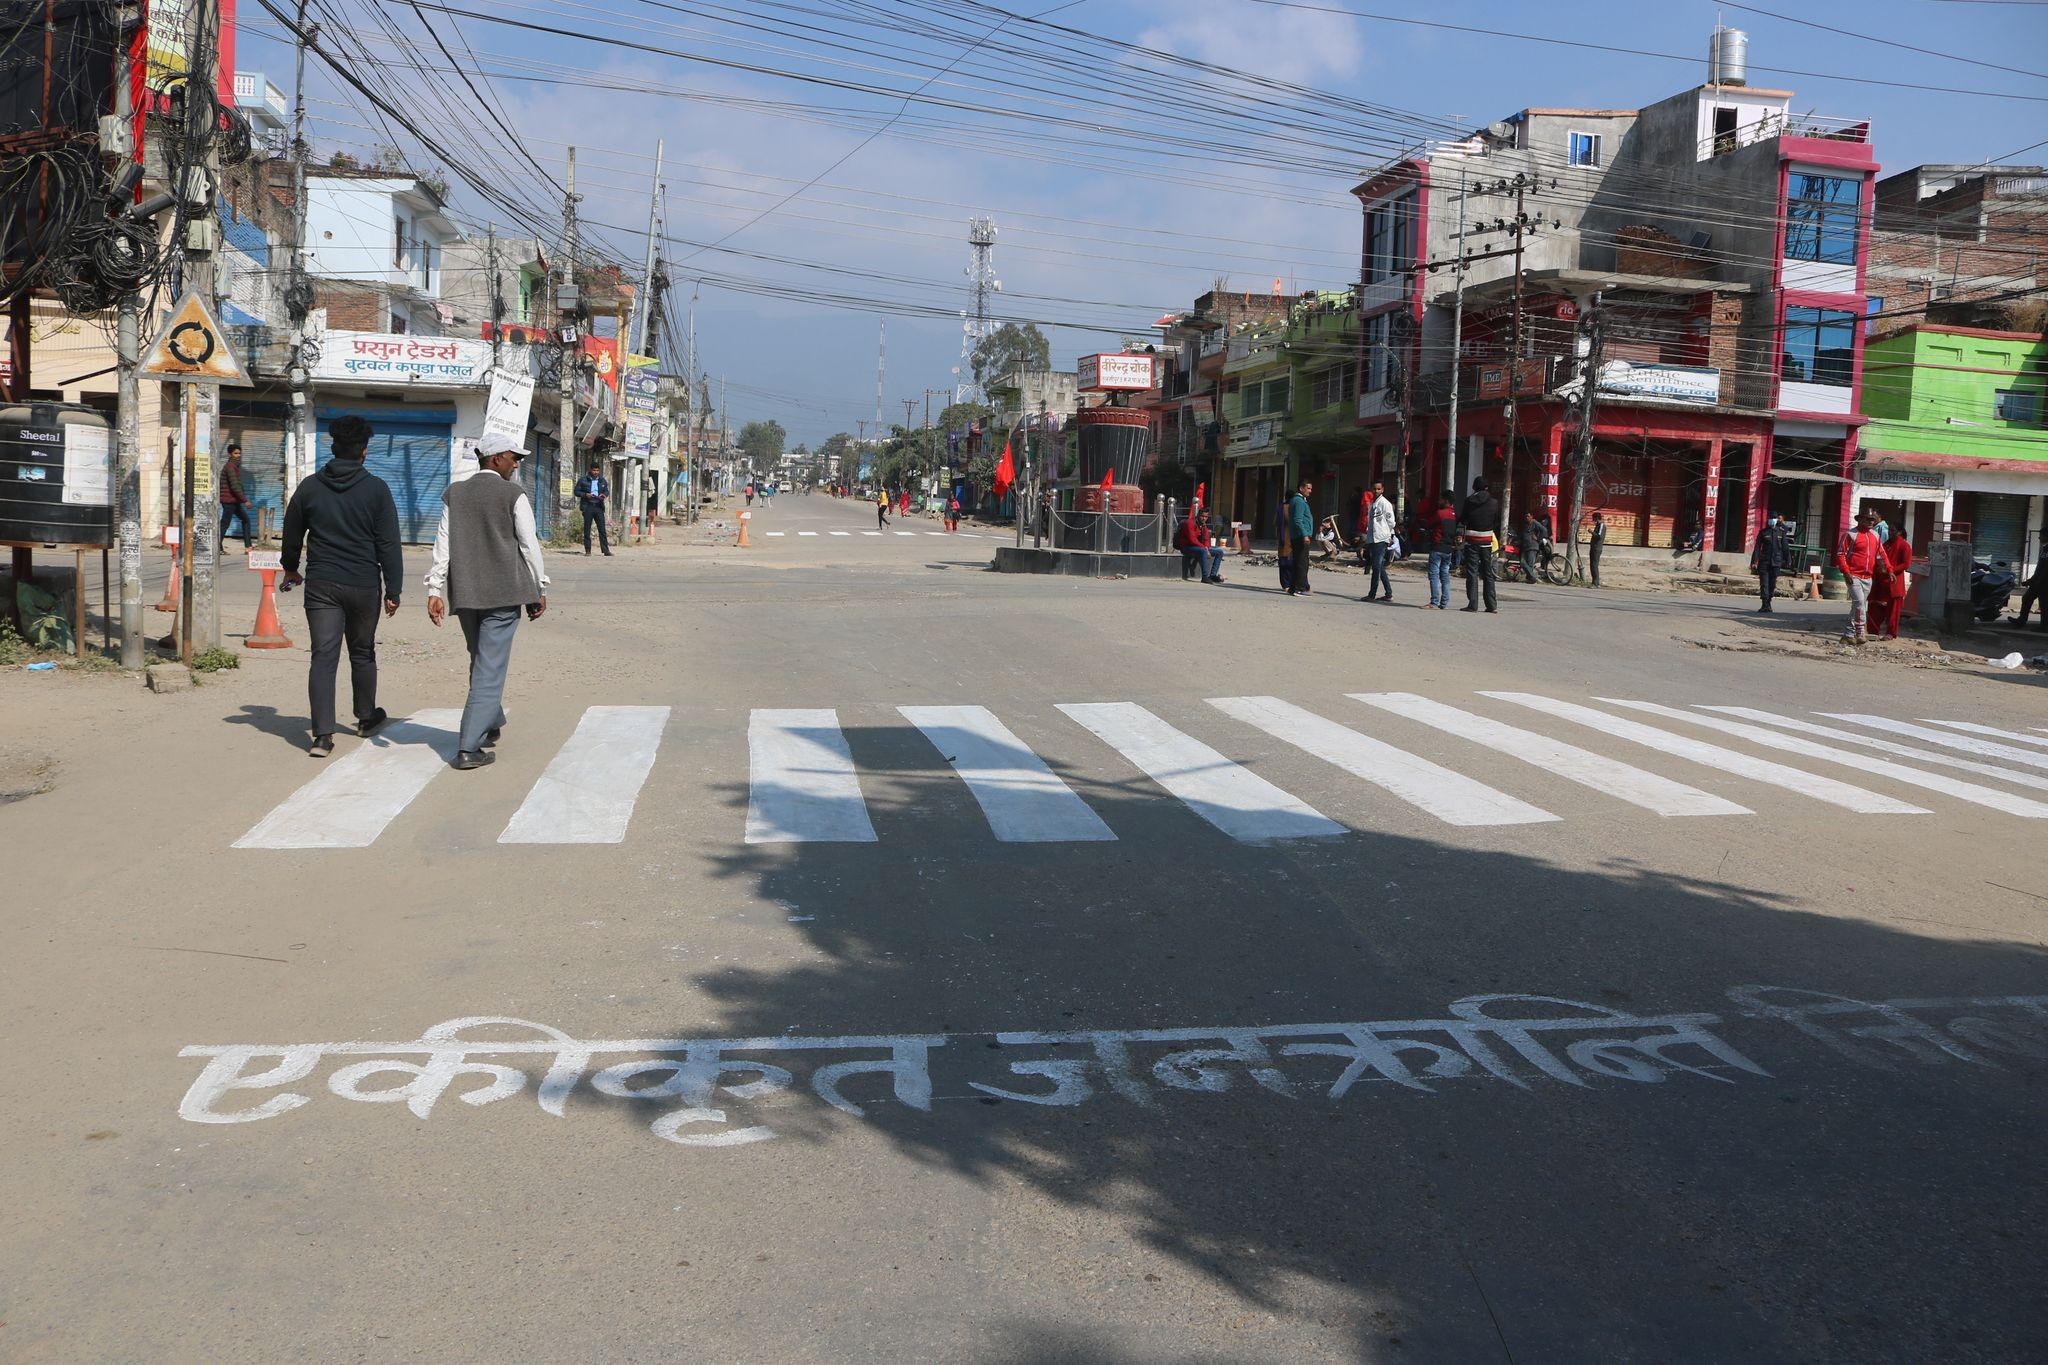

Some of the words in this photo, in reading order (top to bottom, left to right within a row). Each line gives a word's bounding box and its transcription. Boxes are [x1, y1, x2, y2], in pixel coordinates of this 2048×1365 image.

[1558, 303, 1574, 315] ria
[352, 340, 403, 360] प्रसुन
[406, 340, 459, 360] ट्रेडर्स
[344, 358, 393, 374] बुटवल
[1101, 358, 1130, 375] वीरेन्द्र
[1130, 359, 1150, 373] चोक
[1626, 367, 1680, 379] Public
[1625, 374, 1706, 388] Remittance
[20, 429, 60, 442] Sheetal
[176, 1016, 946, 1147] एकीकृत
